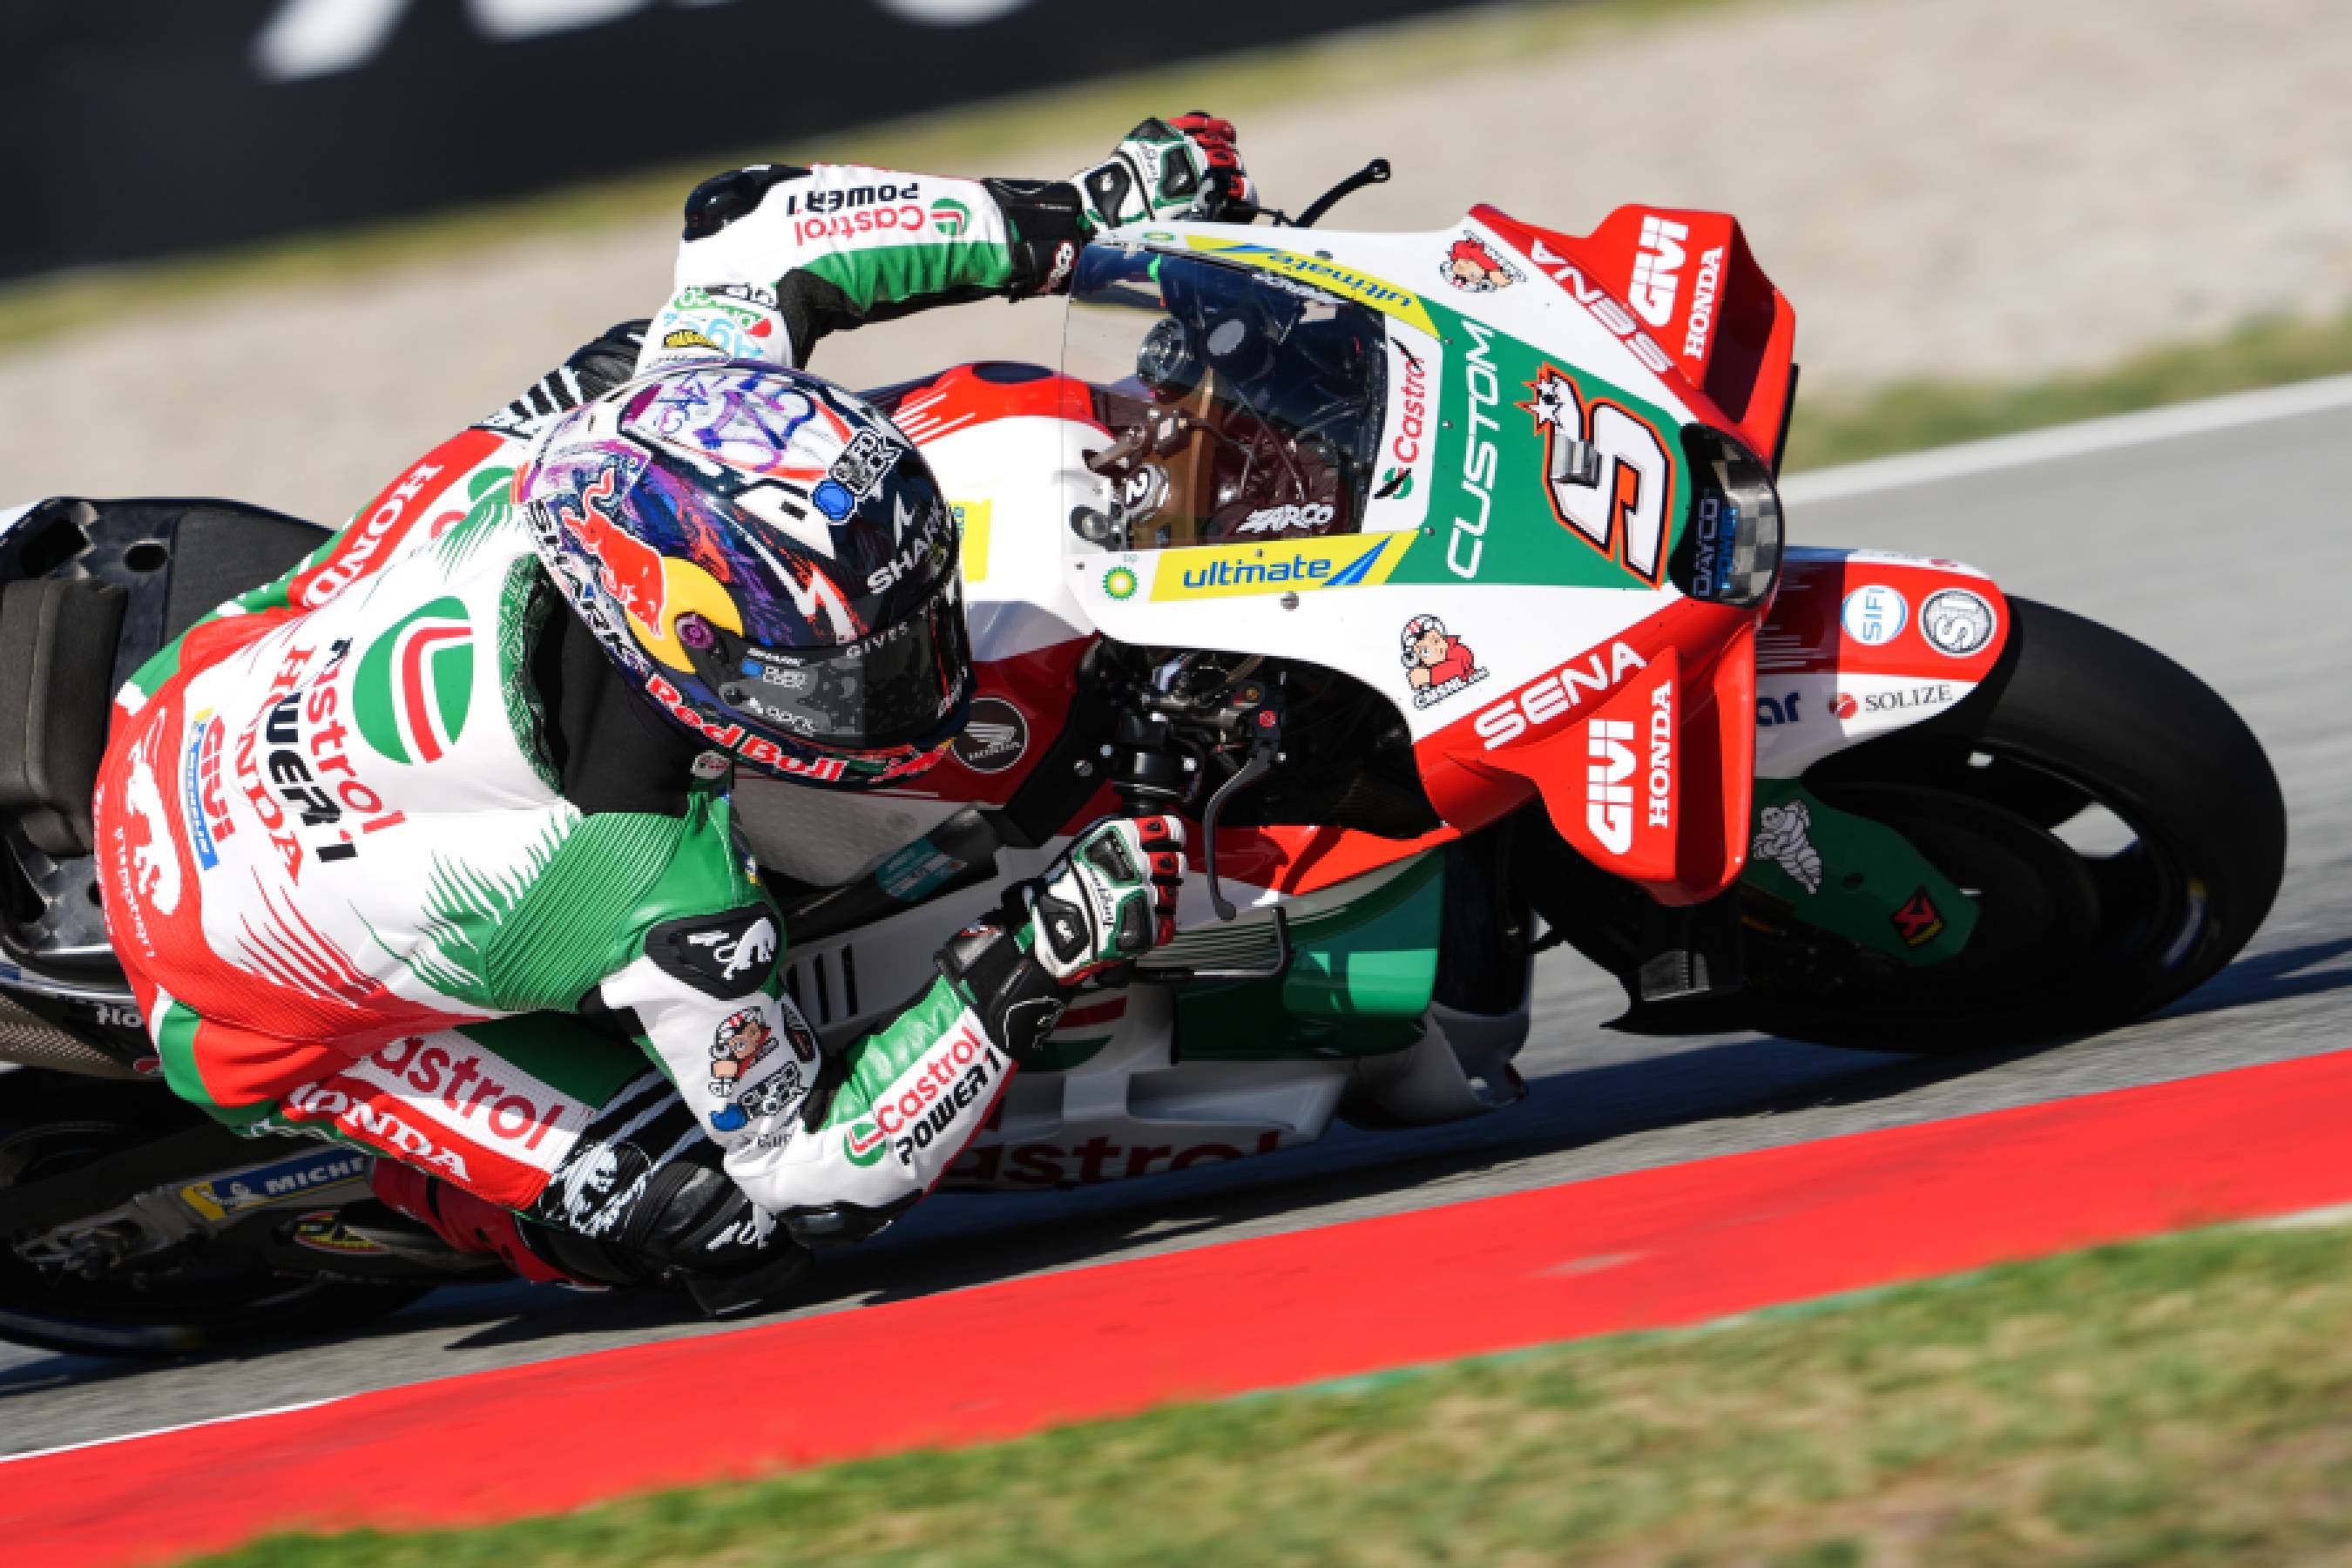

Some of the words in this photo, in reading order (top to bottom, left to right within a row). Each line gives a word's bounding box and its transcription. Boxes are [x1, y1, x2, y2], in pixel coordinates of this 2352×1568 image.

[794, 204, 926, 247] Castrol
[804, 182, 921, 213] POWER
[1267, 253, 1415, 307] ultimate
[1531, 237, 1675, 374] SENA
[1627, 215, 1688, 328] GIVI
[1682, 247, 1724, 362] HONDA
[1393, 357, 1425, 463] Castrol
[1446, 320, 1500, 579] CUSTOM
[1546, 366, 1673, 588] 5
[302, 463, 444, 608] HOND
[1184, 554, 1331, 588] ultimate
[1693, 497, 1720, 597] DAYCO
[307, 666, 408, 834] strol
[645, 673, 746, 749] Red
[736, 733, 850, 782] Bull
[1474, 640, 1648, 751] SENA
[1864, 683, 1954, 712] SOLIZE
[200, 715, 236, 842] GIVI
[1585, 719, 1637, 855] GIVI
[1648, 679, 1673, 828] HONDA
[371, 1036, 565, 1151] astrol
[876, 1024, 982, 1133] Castrol
[896, 1063, 989, 1166] POWER
[263, 1156, 366, 1196] MICHE
